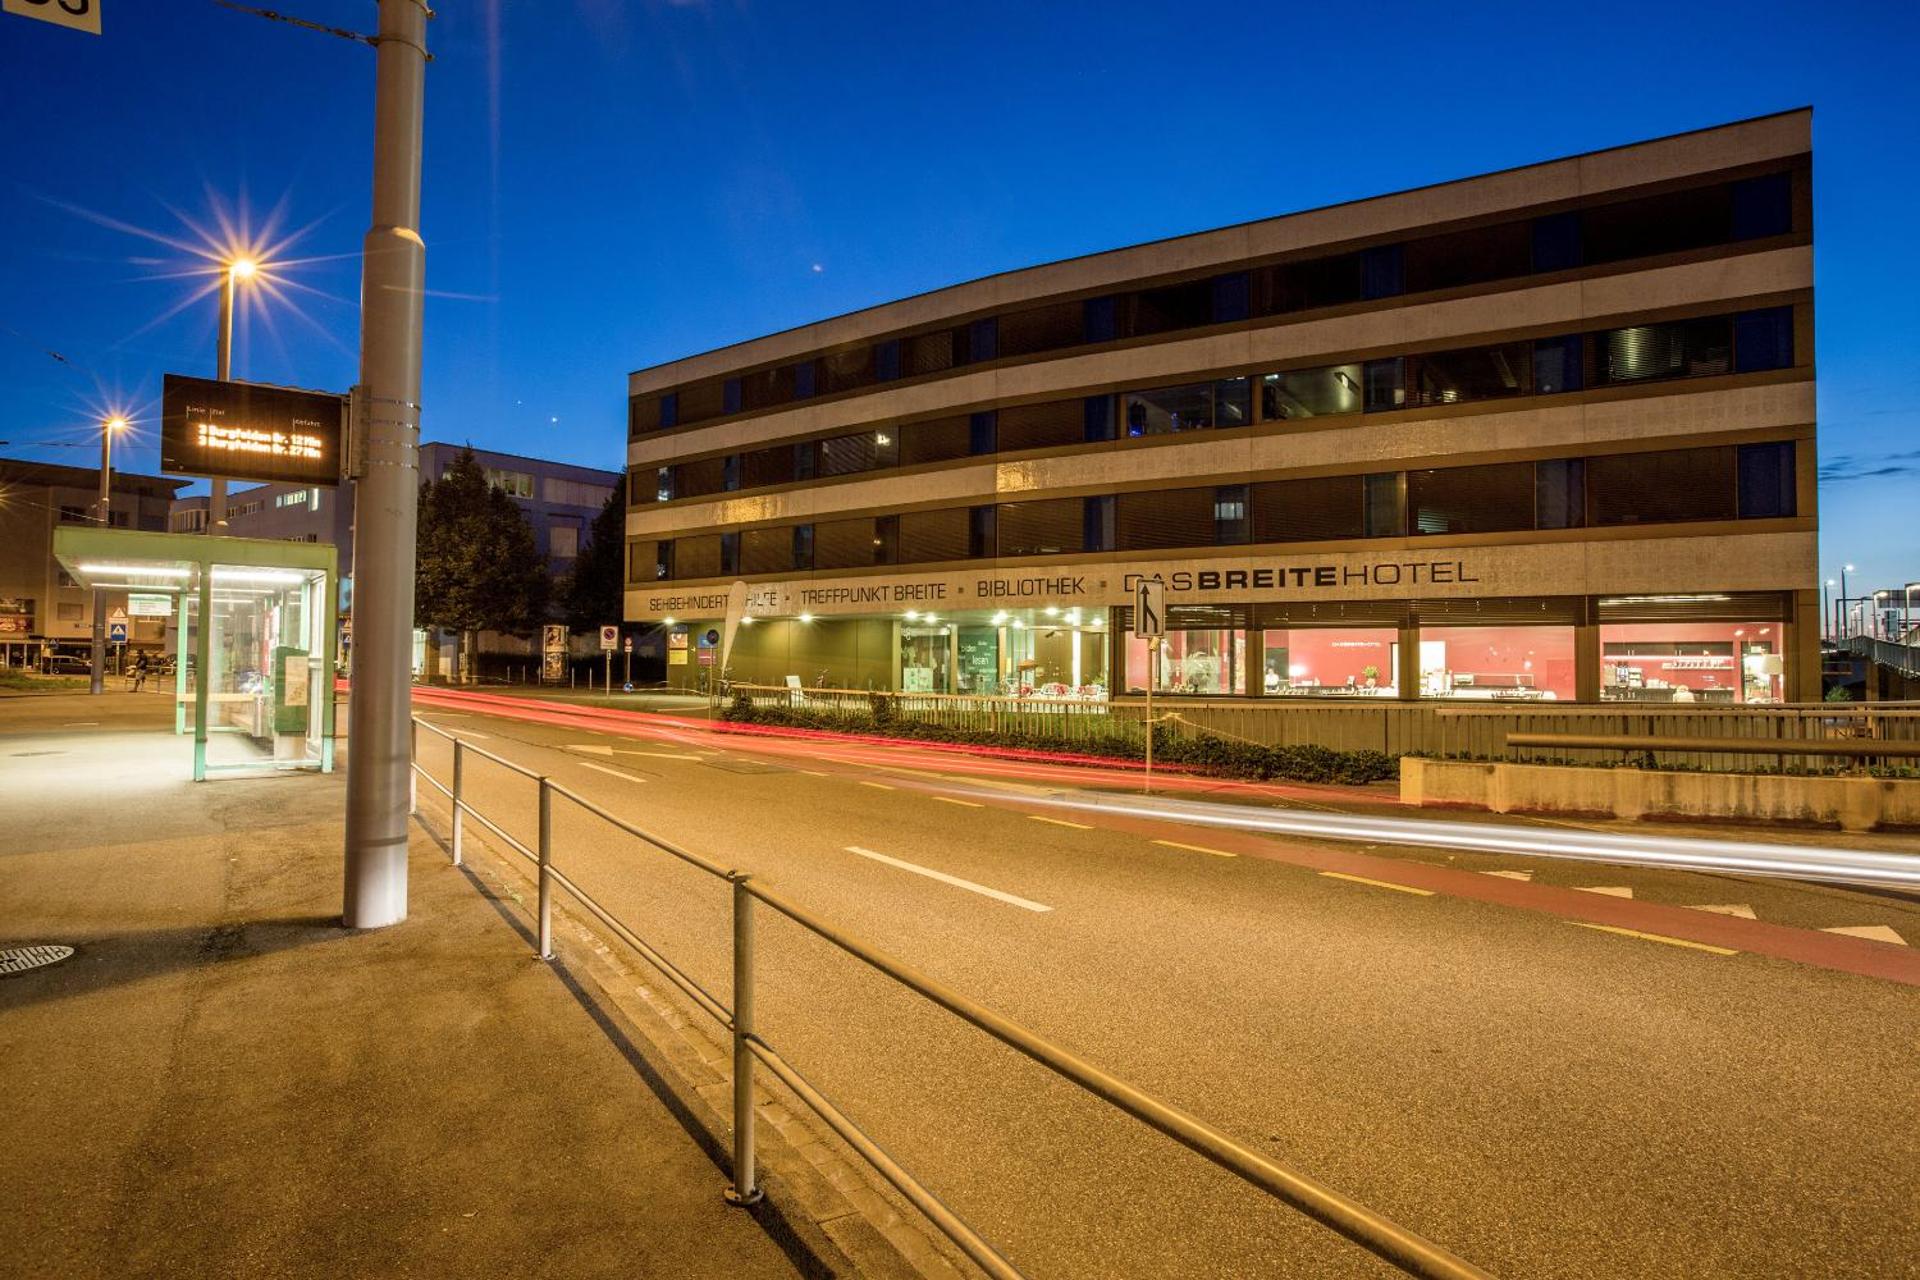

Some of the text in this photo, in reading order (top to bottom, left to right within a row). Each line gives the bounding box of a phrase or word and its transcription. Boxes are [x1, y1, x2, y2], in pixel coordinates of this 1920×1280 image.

[800, 583, 947, 605] TREFFPUNKT BREITE
[977, 576, 1086, 598] BIBLIOTHEK
